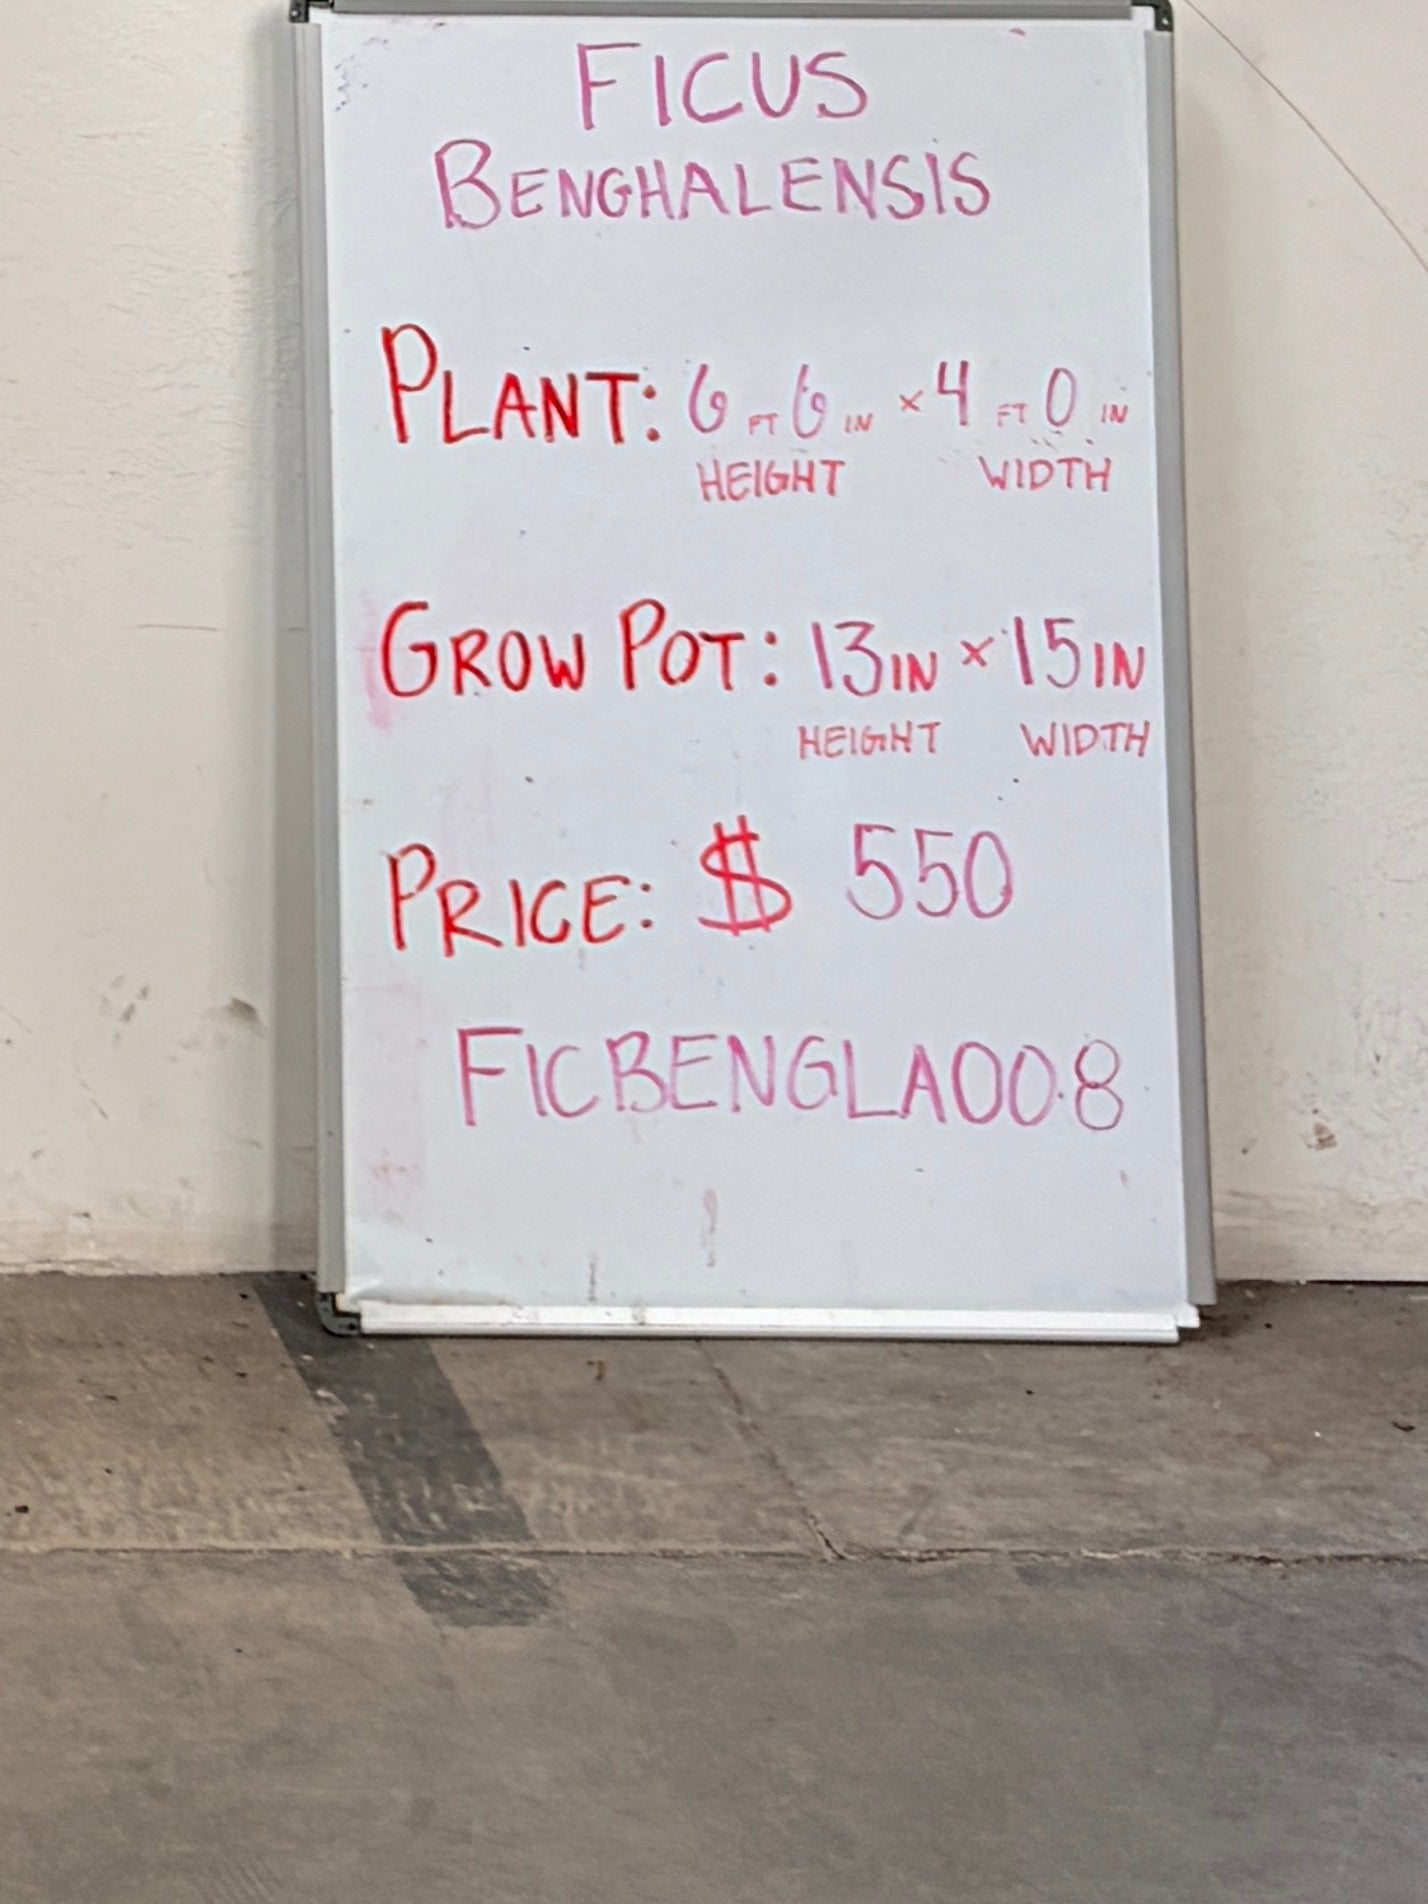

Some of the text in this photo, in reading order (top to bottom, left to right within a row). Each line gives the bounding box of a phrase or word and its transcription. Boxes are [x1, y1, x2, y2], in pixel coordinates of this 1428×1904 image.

[576, 42, 869, 132] FICUS
[433, 139, 991, 231] BENGHALENSIS
[379, 322, 661, 447] PLANT:
[687, 363, 728, 434] 6
[746, 413, 777, 433] FT
[793, 358, 832, 441] 6
[844, 409, 873, 433] IN
[935, 360, 970, 427] 4
[998, 402, 1027, 431] FT
[1097, 404, 1128, 425] IN
[697, 456, 1113, 503] HEIGHT WIDTH
[380, 599, 588, 697] GROW
[616, 597, 779, 693] POT:
[797, 721, 1151, 759] HEIGHT WIDTH
[386, 842, 653, 960] PRICE:
[846, 822, 1014, 921] 550
